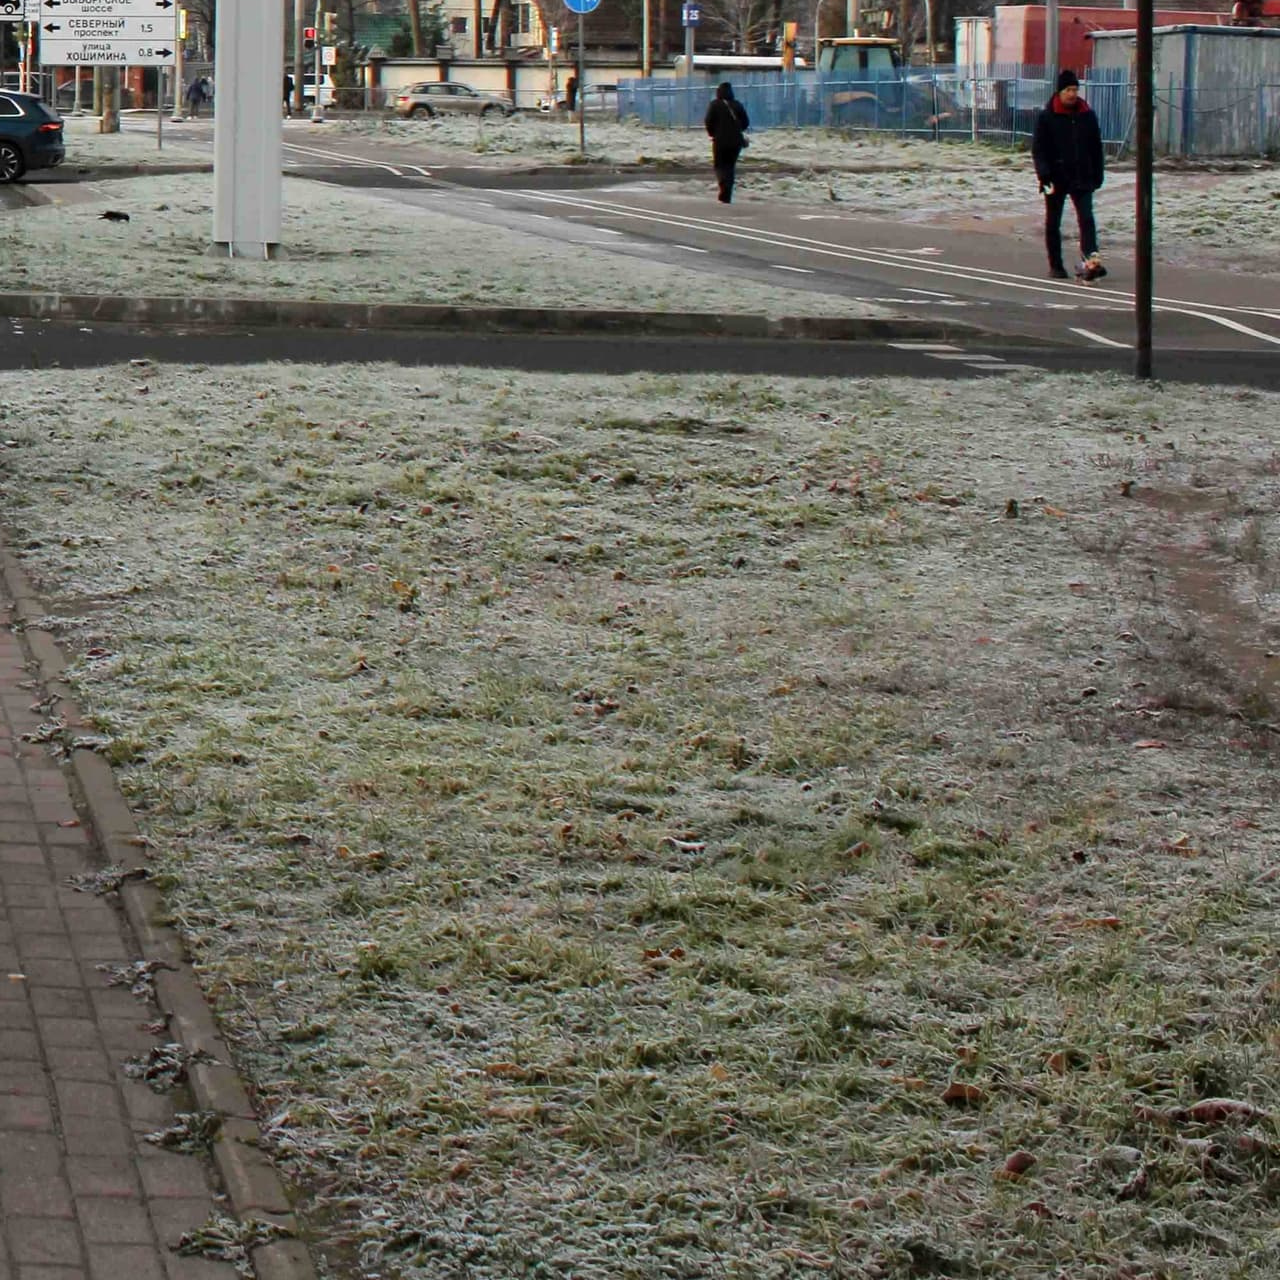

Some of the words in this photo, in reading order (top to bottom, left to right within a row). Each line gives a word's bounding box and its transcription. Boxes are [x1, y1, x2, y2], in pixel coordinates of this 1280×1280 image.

[68, 18, 125, 29] СЕВЕРНЫЙ
[140, 24, 153, 33] 1.5
[82, 43, 111, 52] улица
[138, 48, 153, 57] 0.8
